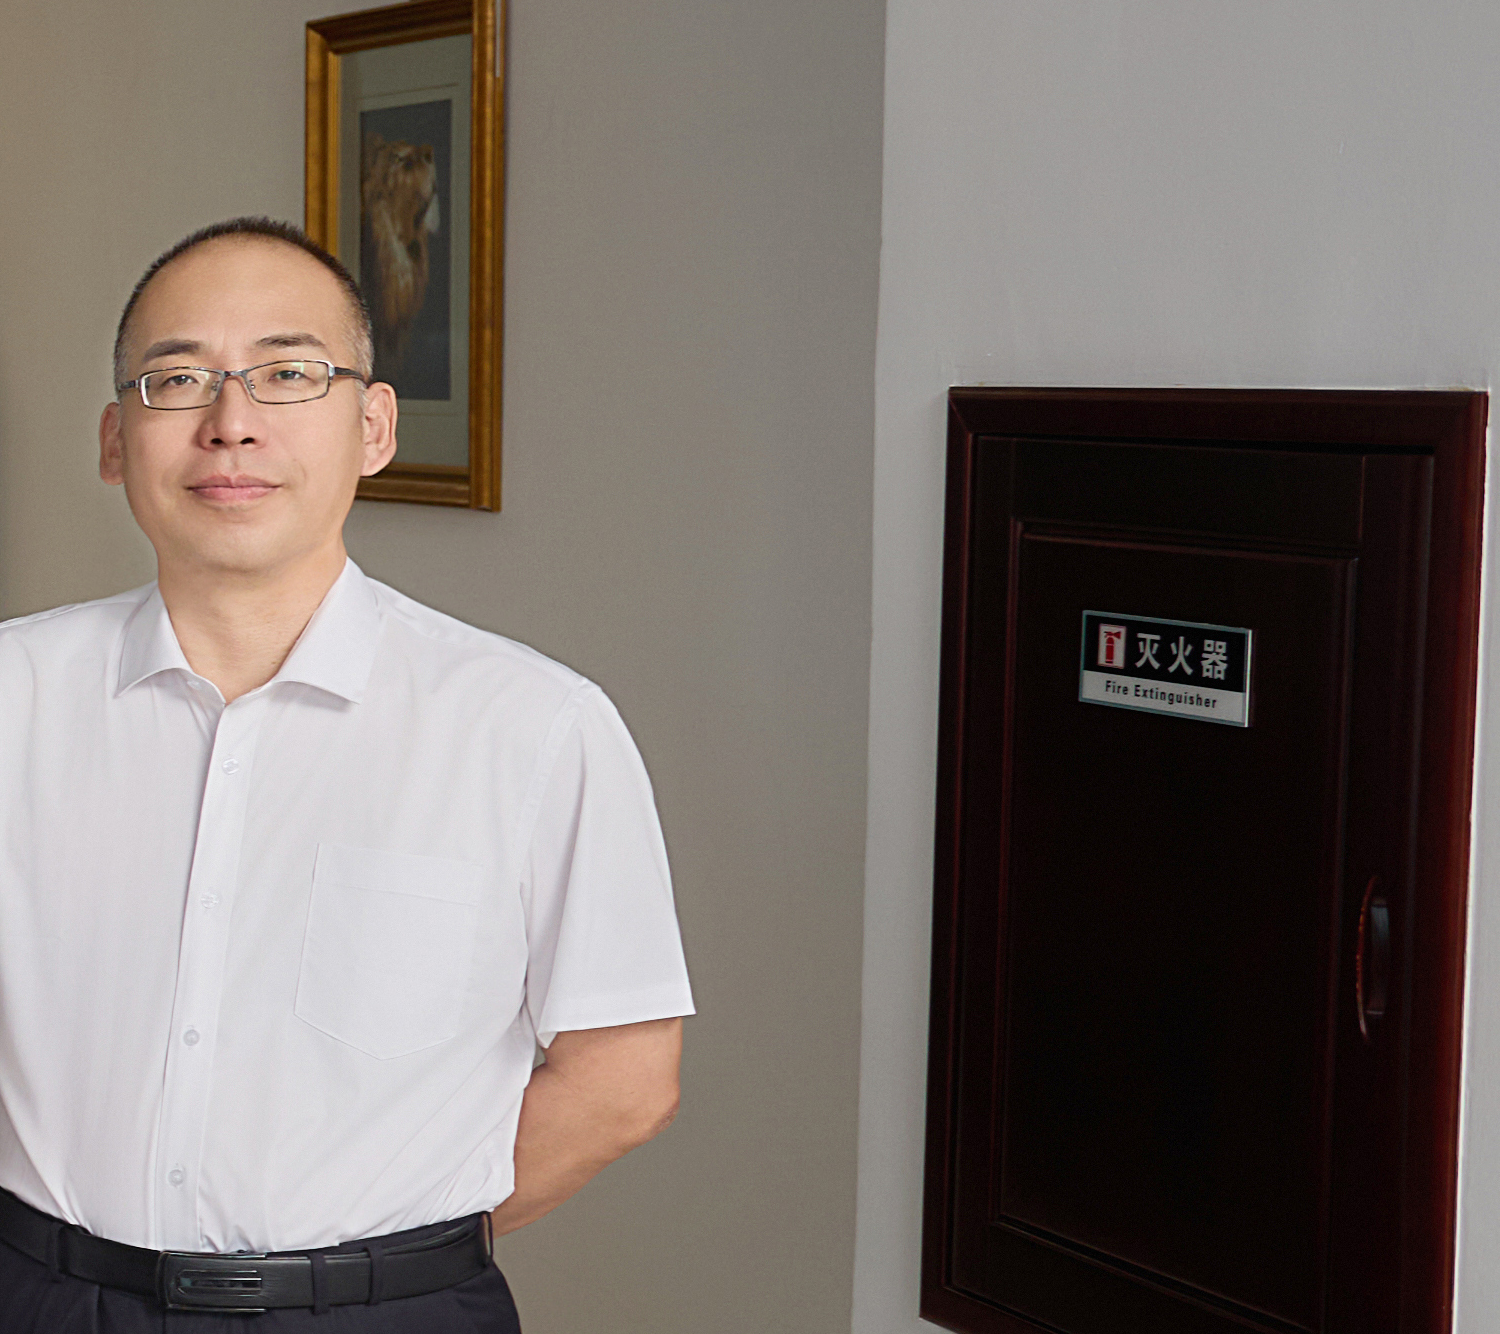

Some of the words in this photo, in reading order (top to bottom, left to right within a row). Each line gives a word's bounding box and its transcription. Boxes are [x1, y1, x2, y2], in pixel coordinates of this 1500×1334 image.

[1135, 632, 1228, 680] 灭火器
[1105, 680, 1129, 696] Fire
[1134, 684, 1218, 708] Extinguisher
